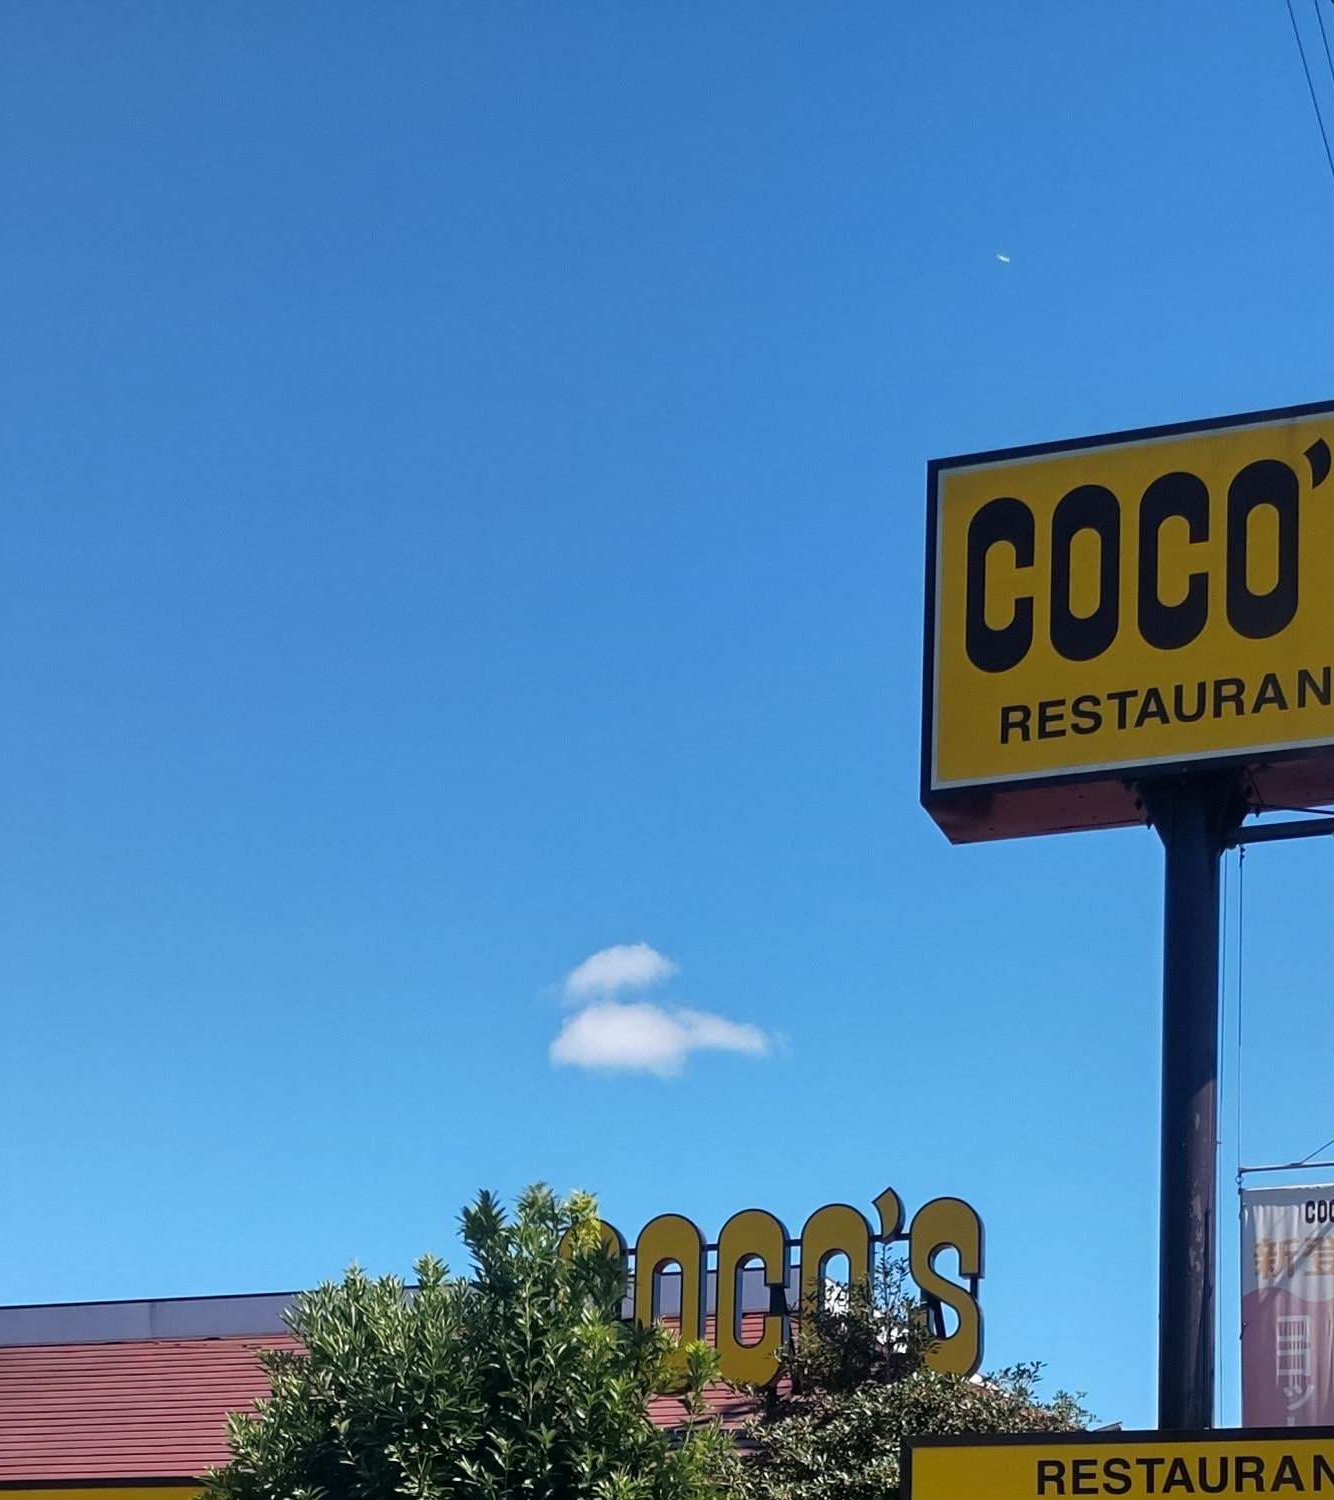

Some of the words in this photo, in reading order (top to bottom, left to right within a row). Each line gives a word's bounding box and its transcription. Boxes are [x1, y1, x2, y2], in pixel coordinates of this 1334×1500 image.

[558, 1187, 985, 1395] OCO'S
[1276, 1314, 1315, 1427] ココッ
